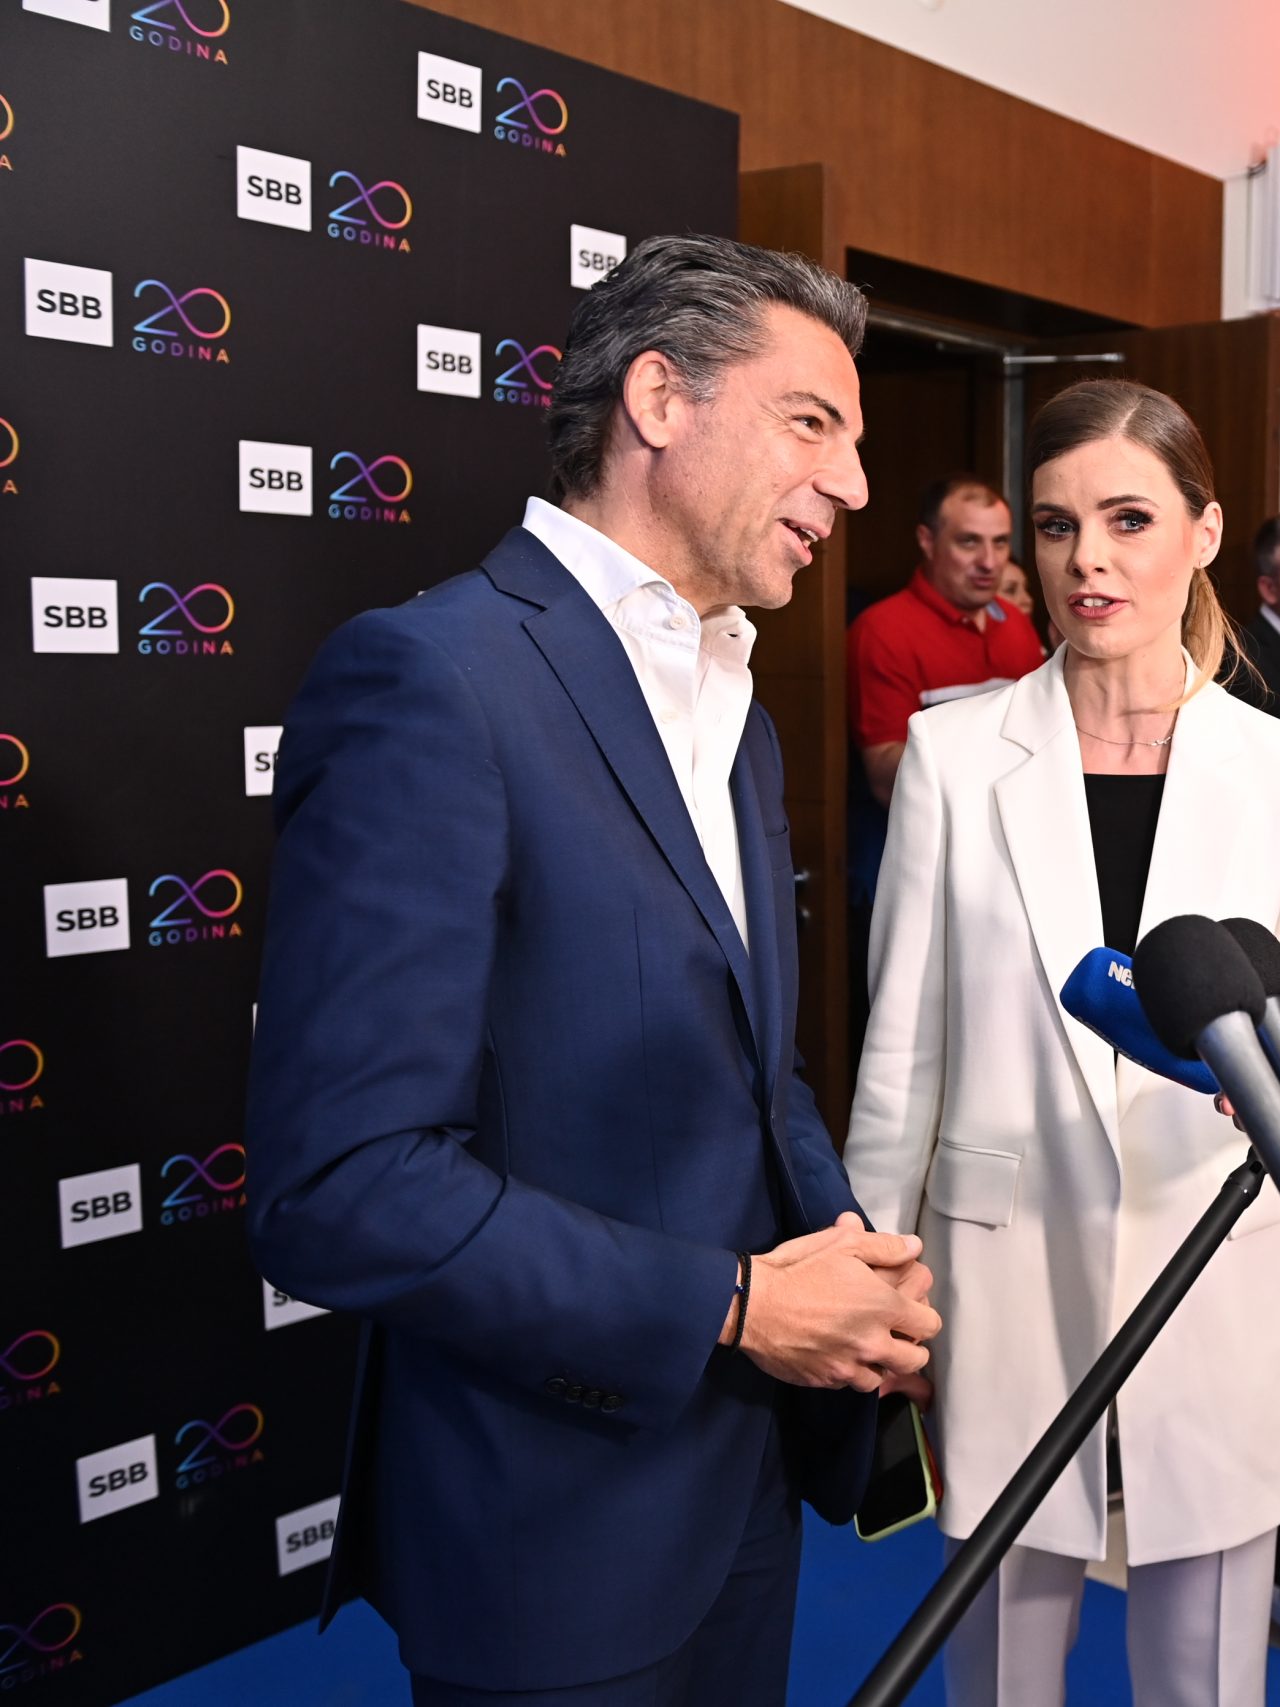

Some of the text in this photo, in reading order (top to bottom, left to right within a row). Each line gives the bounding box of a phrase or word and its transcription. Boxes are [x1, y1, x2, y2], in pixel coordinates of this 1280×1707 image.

[129, 25, 229, 66] GODINA
[427, 79, 473, 109] SBB
[496, 78, 569, 136] 20
[494, 127, 568, 158] GODINA
[247, 175, 302, 205] SBB
[329, 171, 413, 231] 20
[328, 223, 412, 255] GODINA
[37, 289, 102, 320] SBB
[136, 279, 232, 340] 20
[133, 338, 231, 366] GODINA
[427, 351, 473, 375] SBB
[494, 387, 553, 407] GODIN
[249, 467, 304, 492] SBB
[330, 450, 414, 503] 20
[329, 502, 412, 524] GODINA
[44, 605, 108, 629] SBB
[139, 581, 236, 637] 20
[138, 638, 236, 657] GODINA
[148, 868, 243, 929] 20
[56, 905, 120, 933] SBB
[149, 922, 242, 946] GODINA
[1108, 961, 1136, 989] Ne
[161, 1143, 246, 1208] 20
[70, 1191, 132, 1223] SBB
[0, 1382, 61, 1409] DINA
[175, 1403, 264, 1473] 20
[88, 1461, 149, 1498] SBB
[176, 1449, 264, 1489] GODINA
[286, 1519, 335, 1554] SBB
[1, 1649, 84, 1690] ODINA
